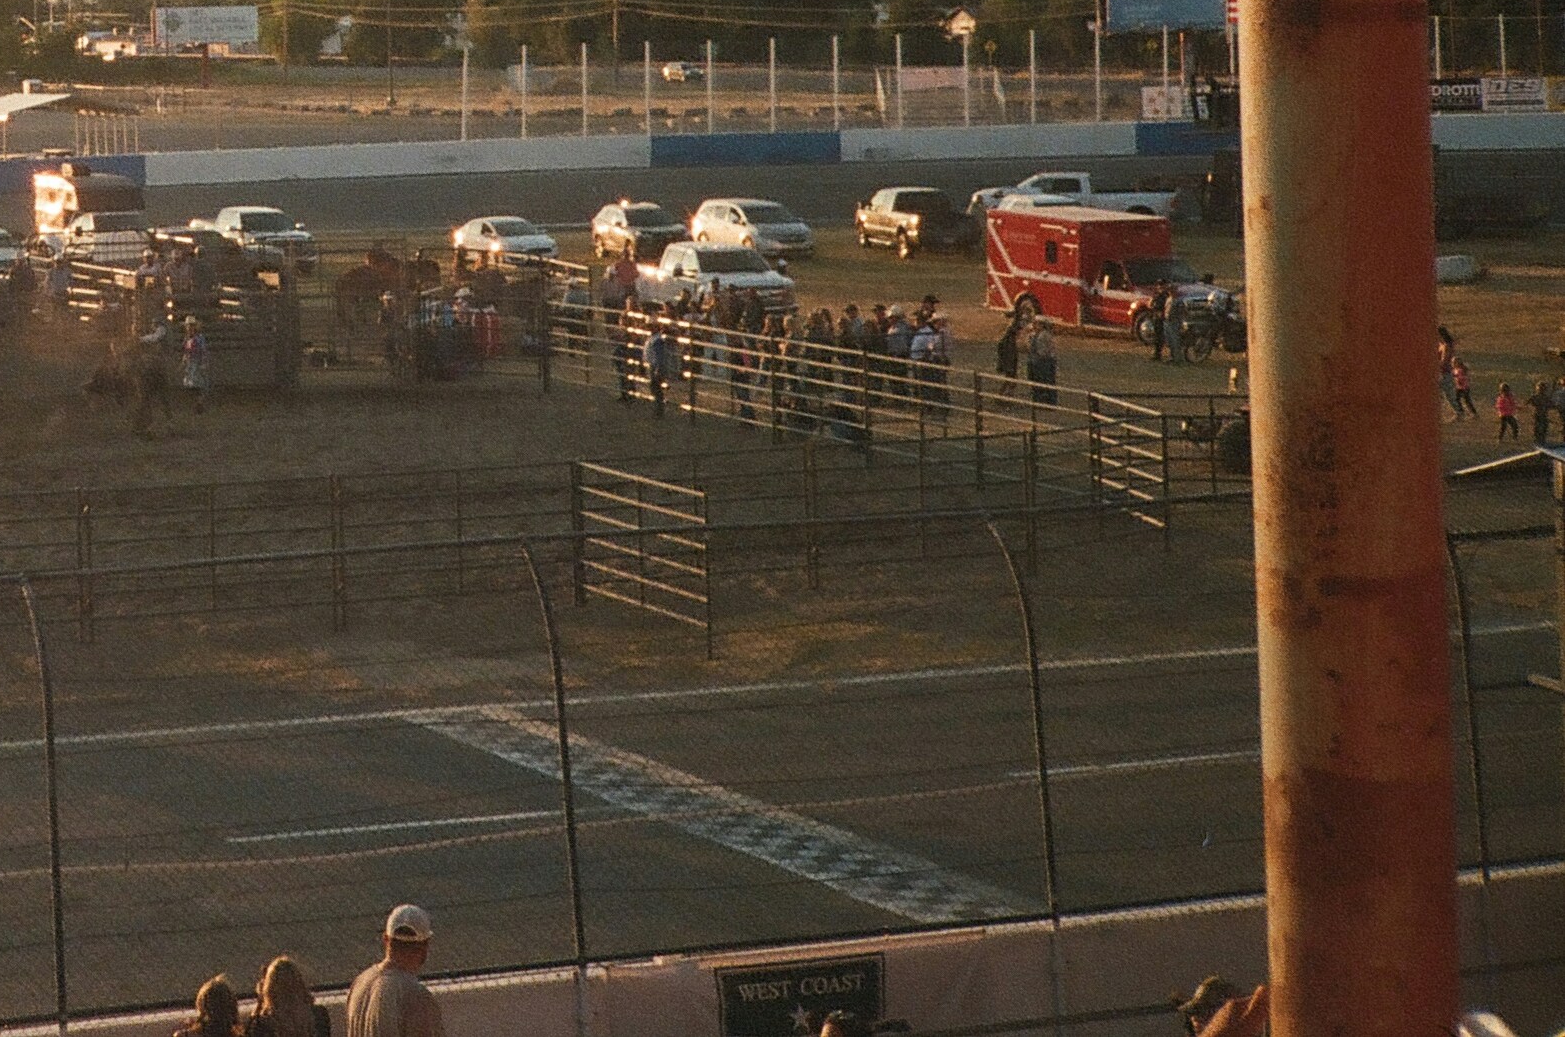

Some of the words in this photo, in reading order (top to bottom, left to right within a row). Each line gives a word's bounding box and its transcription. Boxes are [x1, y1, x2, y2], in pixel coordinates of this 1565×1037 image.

[1429, 84, 1481, 97] DROTTI
[738, 980, 792, 1003] WEST
[800, 973, 865, 996] COAST
